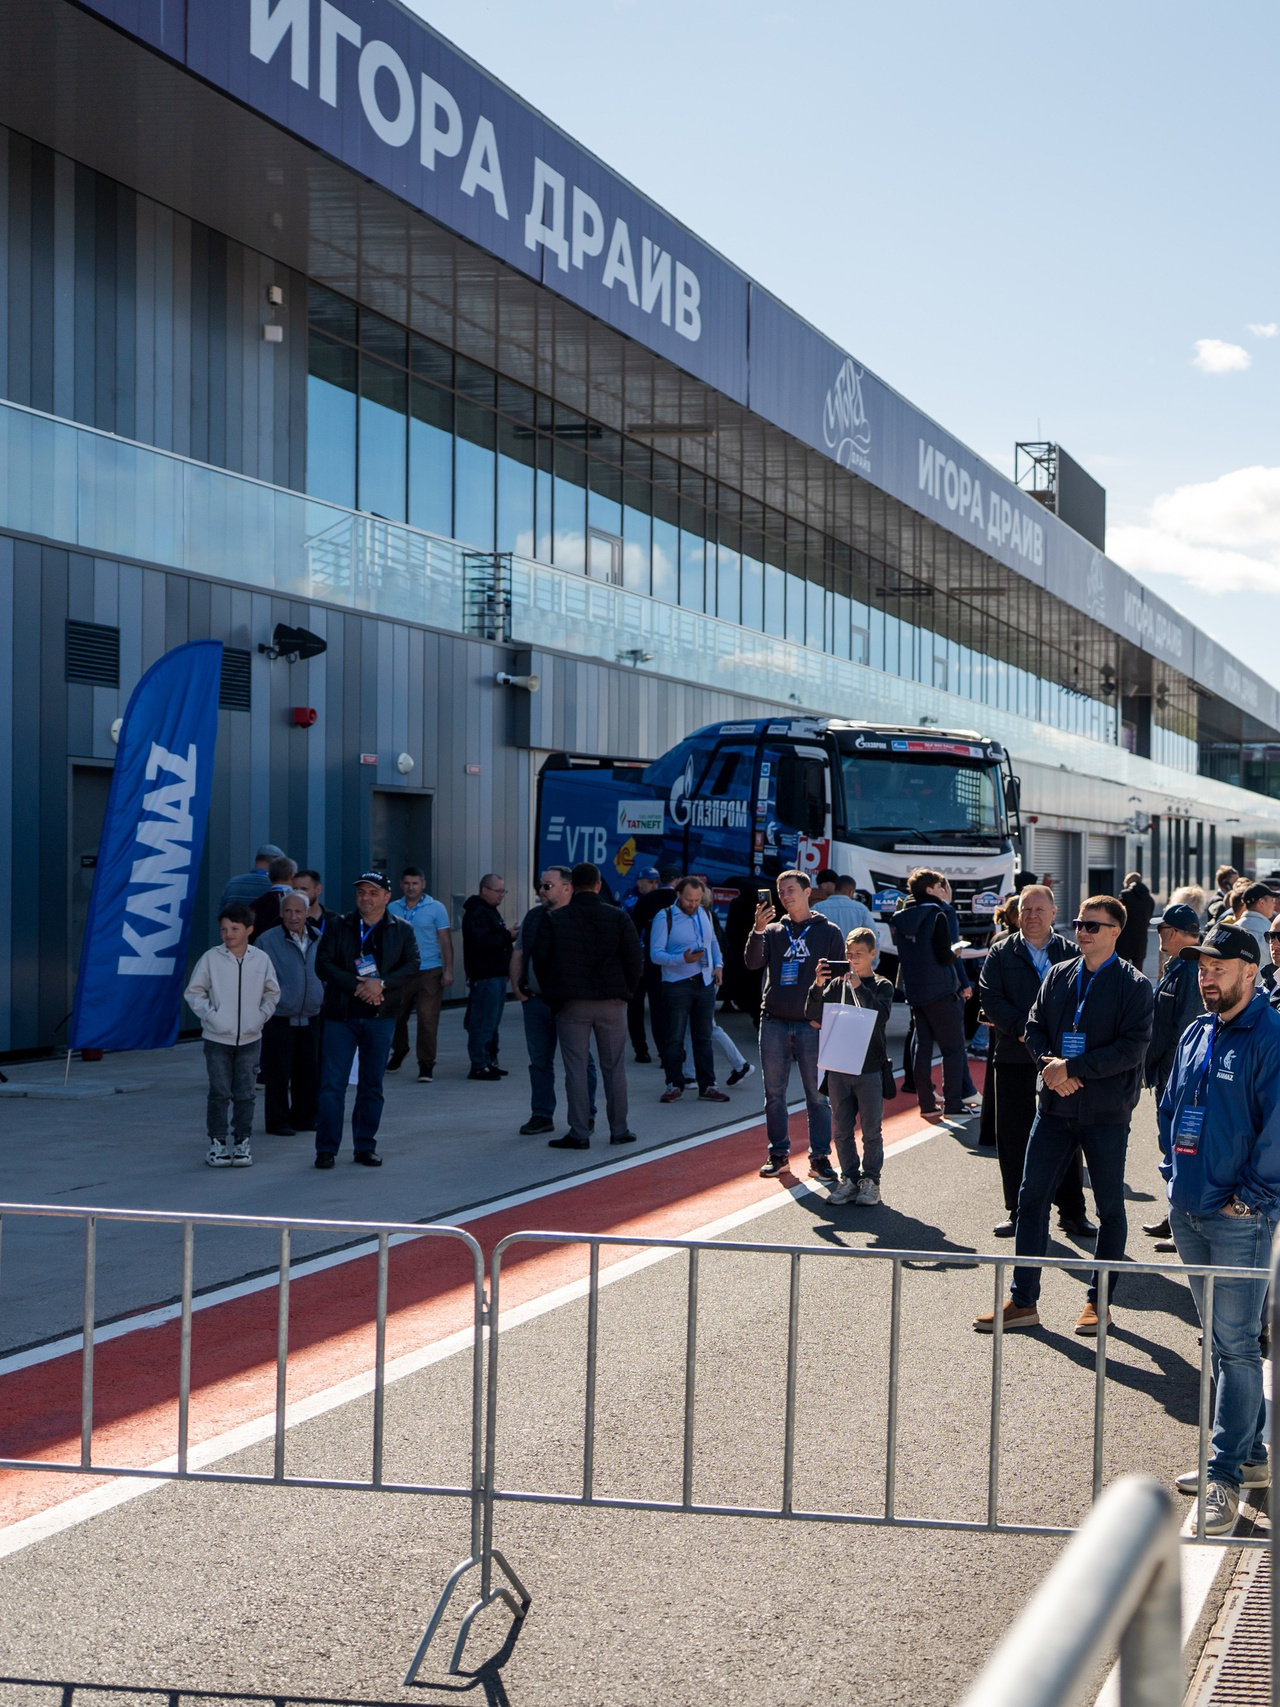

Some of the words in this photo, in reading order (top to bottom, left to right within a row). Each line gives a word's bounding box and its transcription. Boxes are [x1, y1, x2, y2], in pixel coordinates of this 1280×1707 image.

[249, 0, 509, 220] ИГОРА
[525, 156, 702, 342] ДРАЙВ
[851, 450, 872, 474] ДРАЙВ
[918, 438, 984, 530] ИГОРА
[987, 490, 1044, 566] ДРАЙВ
[627, 820, 661, 829] TATNEFT
[691, 799, 748, 828] ГАЗПРОМ
[117, 741, 197, 976] KAMAZ
[566, 825, 608, 865] VTB
